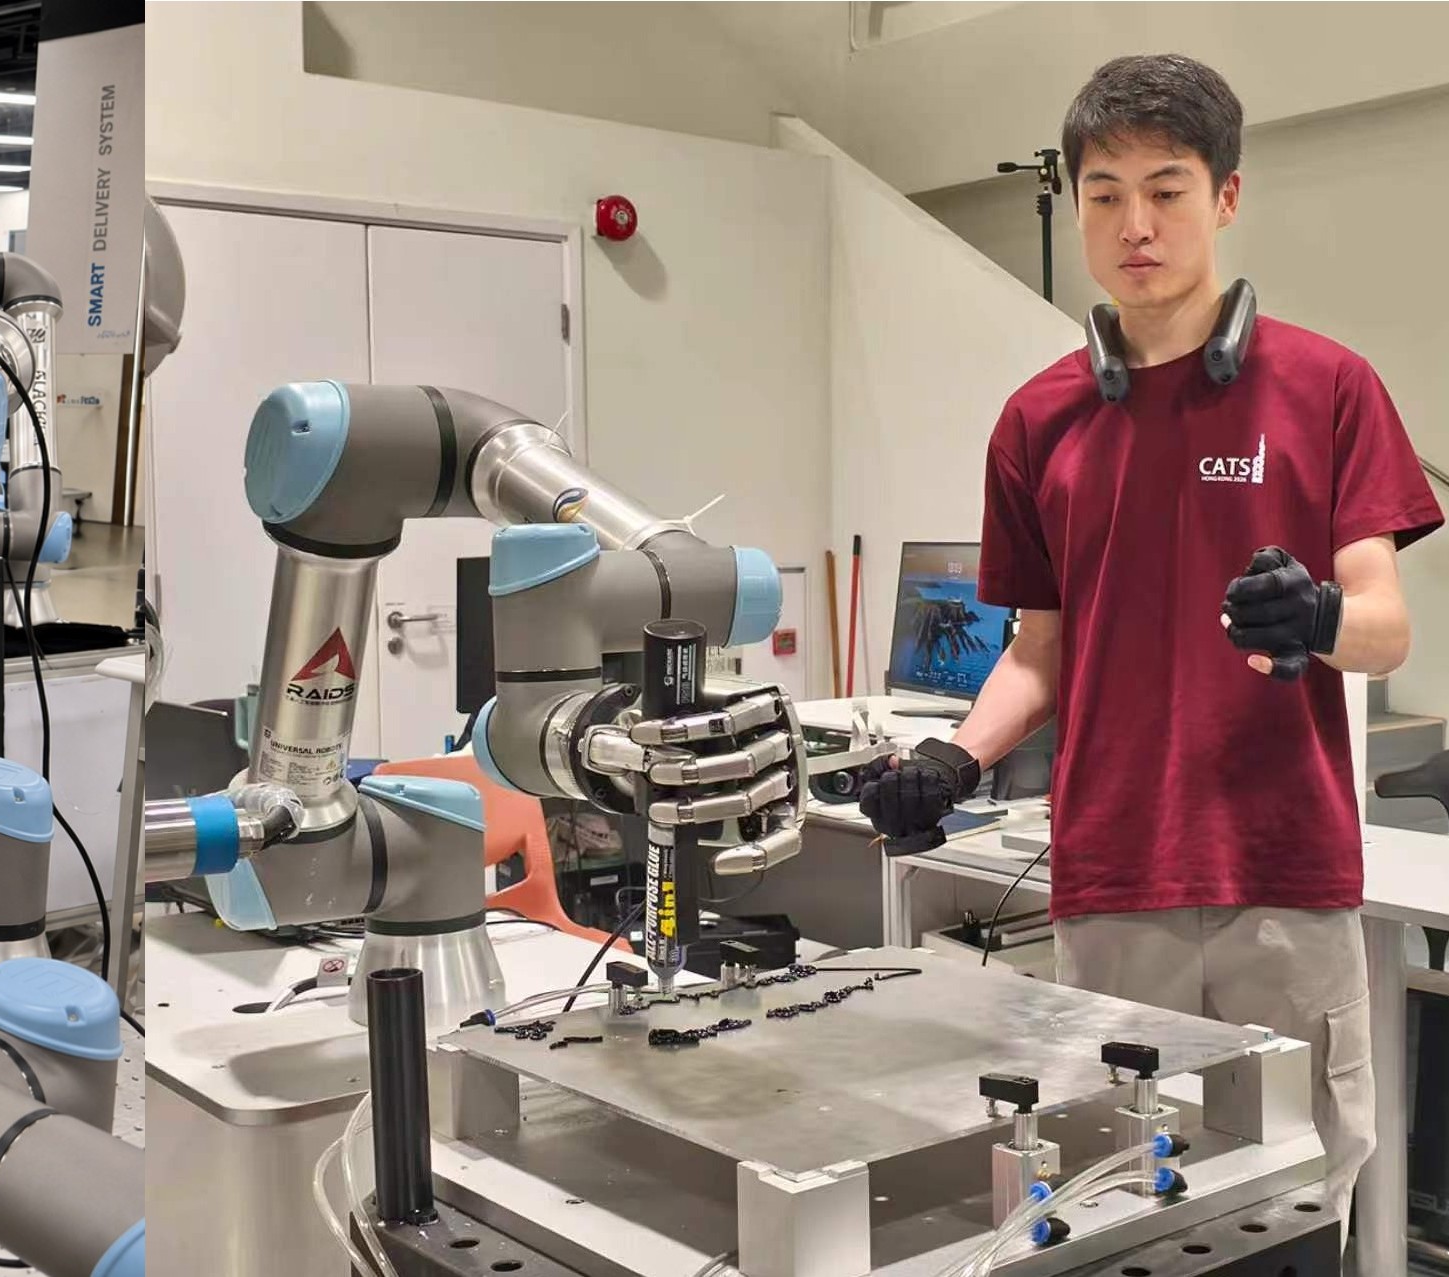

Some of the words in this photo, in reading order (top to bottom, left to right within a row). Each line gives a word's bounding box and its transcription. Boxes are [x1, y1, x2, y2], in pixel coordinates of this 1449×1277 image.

[98, 84, 115, 156] SYSTEM
[93, 167, 111, 252] DELIVERY
[88, 263, 105, 327] SMART
[1199, 457, 1251, 476] CATS
[286, 683, 355, 700] RAIDS
[648, 844, 660, 877] GLUE
